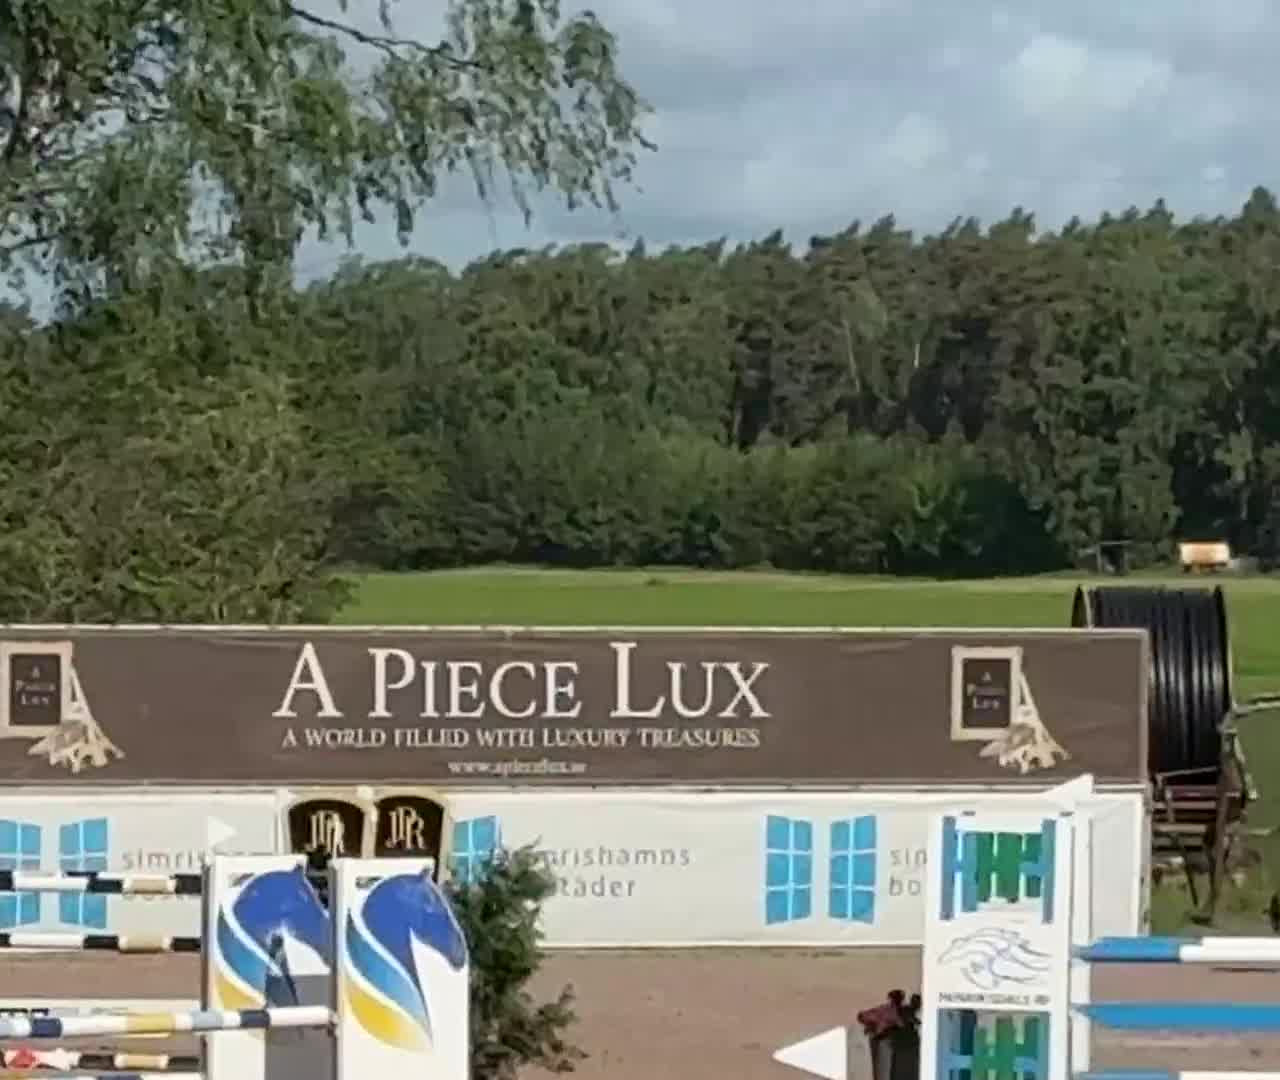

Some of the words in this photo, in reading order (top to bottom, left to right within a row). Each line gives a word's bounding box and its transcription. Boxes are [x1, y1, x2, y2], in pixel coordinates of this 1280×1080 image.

[272, 641, 344, 718] A
[282, 728, 297, 747] A
[305, 728, 386, 748] WORLD
[394, 728, 469, 747] FILLED
[476, 728, 535, 748] WITH
[543, 728, 630, 748] LUXURY
[637, 728, 761, 748] TREASURES
